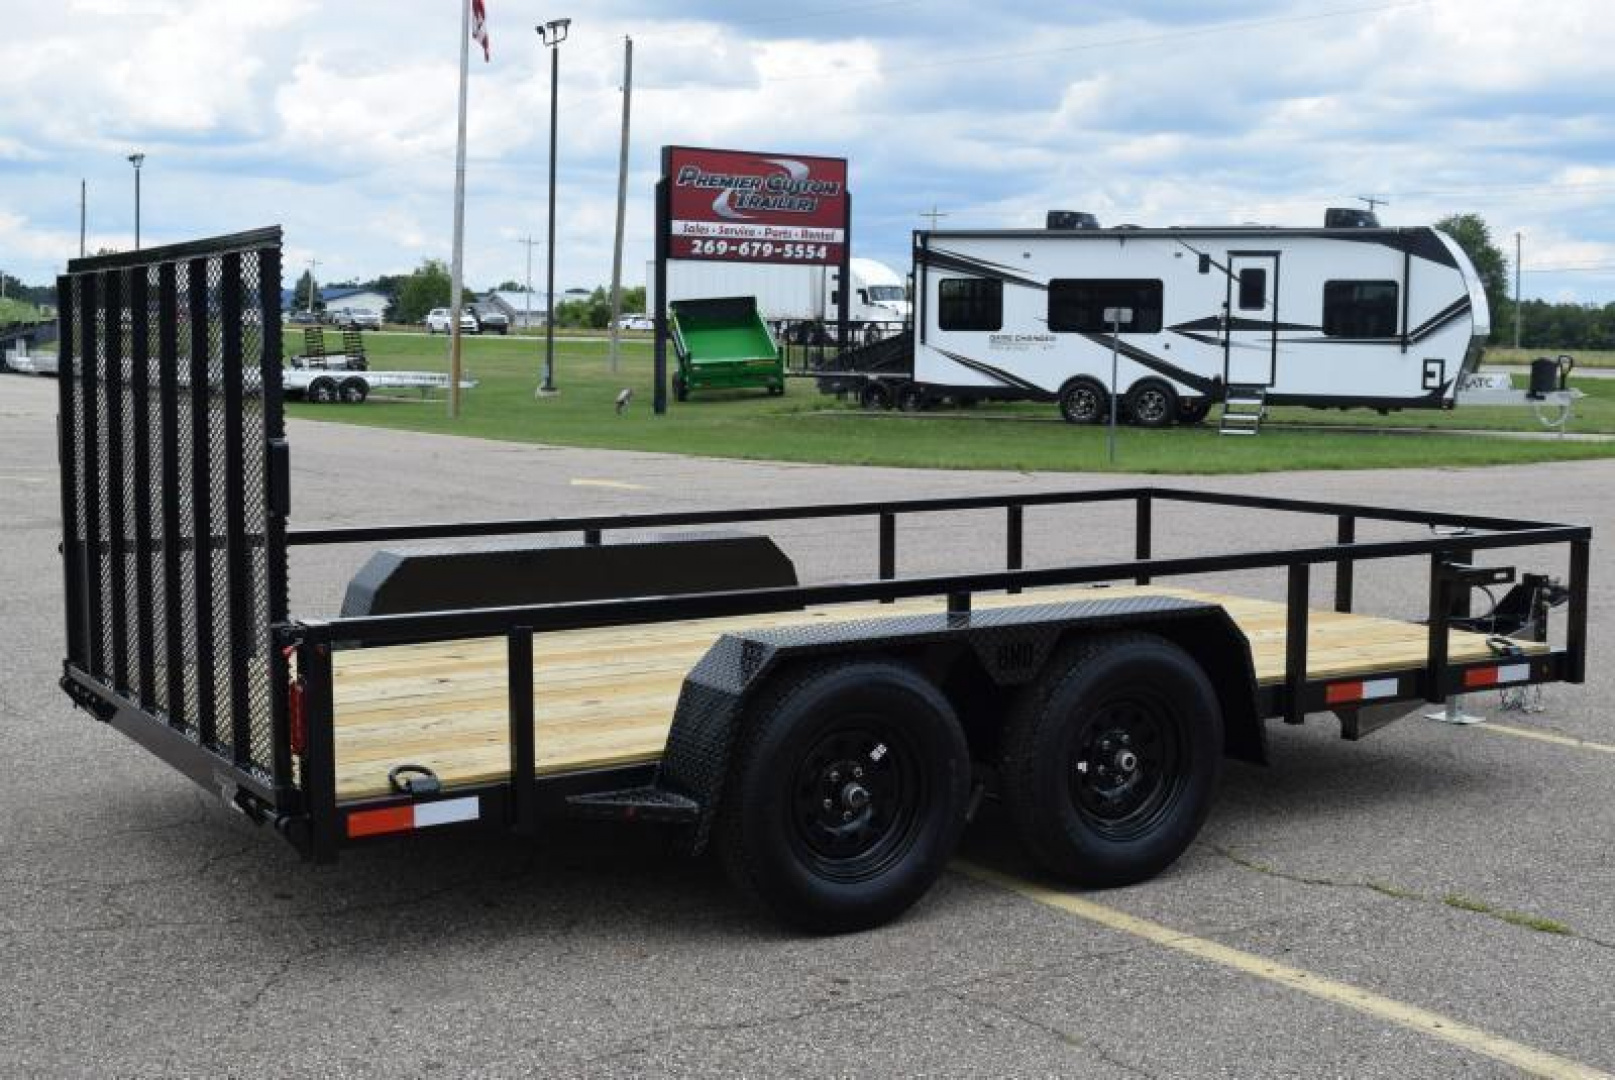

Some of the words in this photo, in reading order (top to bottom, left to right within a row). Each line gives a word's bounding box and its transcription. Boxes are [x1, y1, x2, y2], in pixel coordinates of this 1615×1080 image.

[683, 223, 710, 235] Sales
[718, 225, 756, 237] Service
[764, 228, 792, 240] Parts
[801, 230, 836, 242] Rental
[690, 239, 827, 259] 269-679-5554
